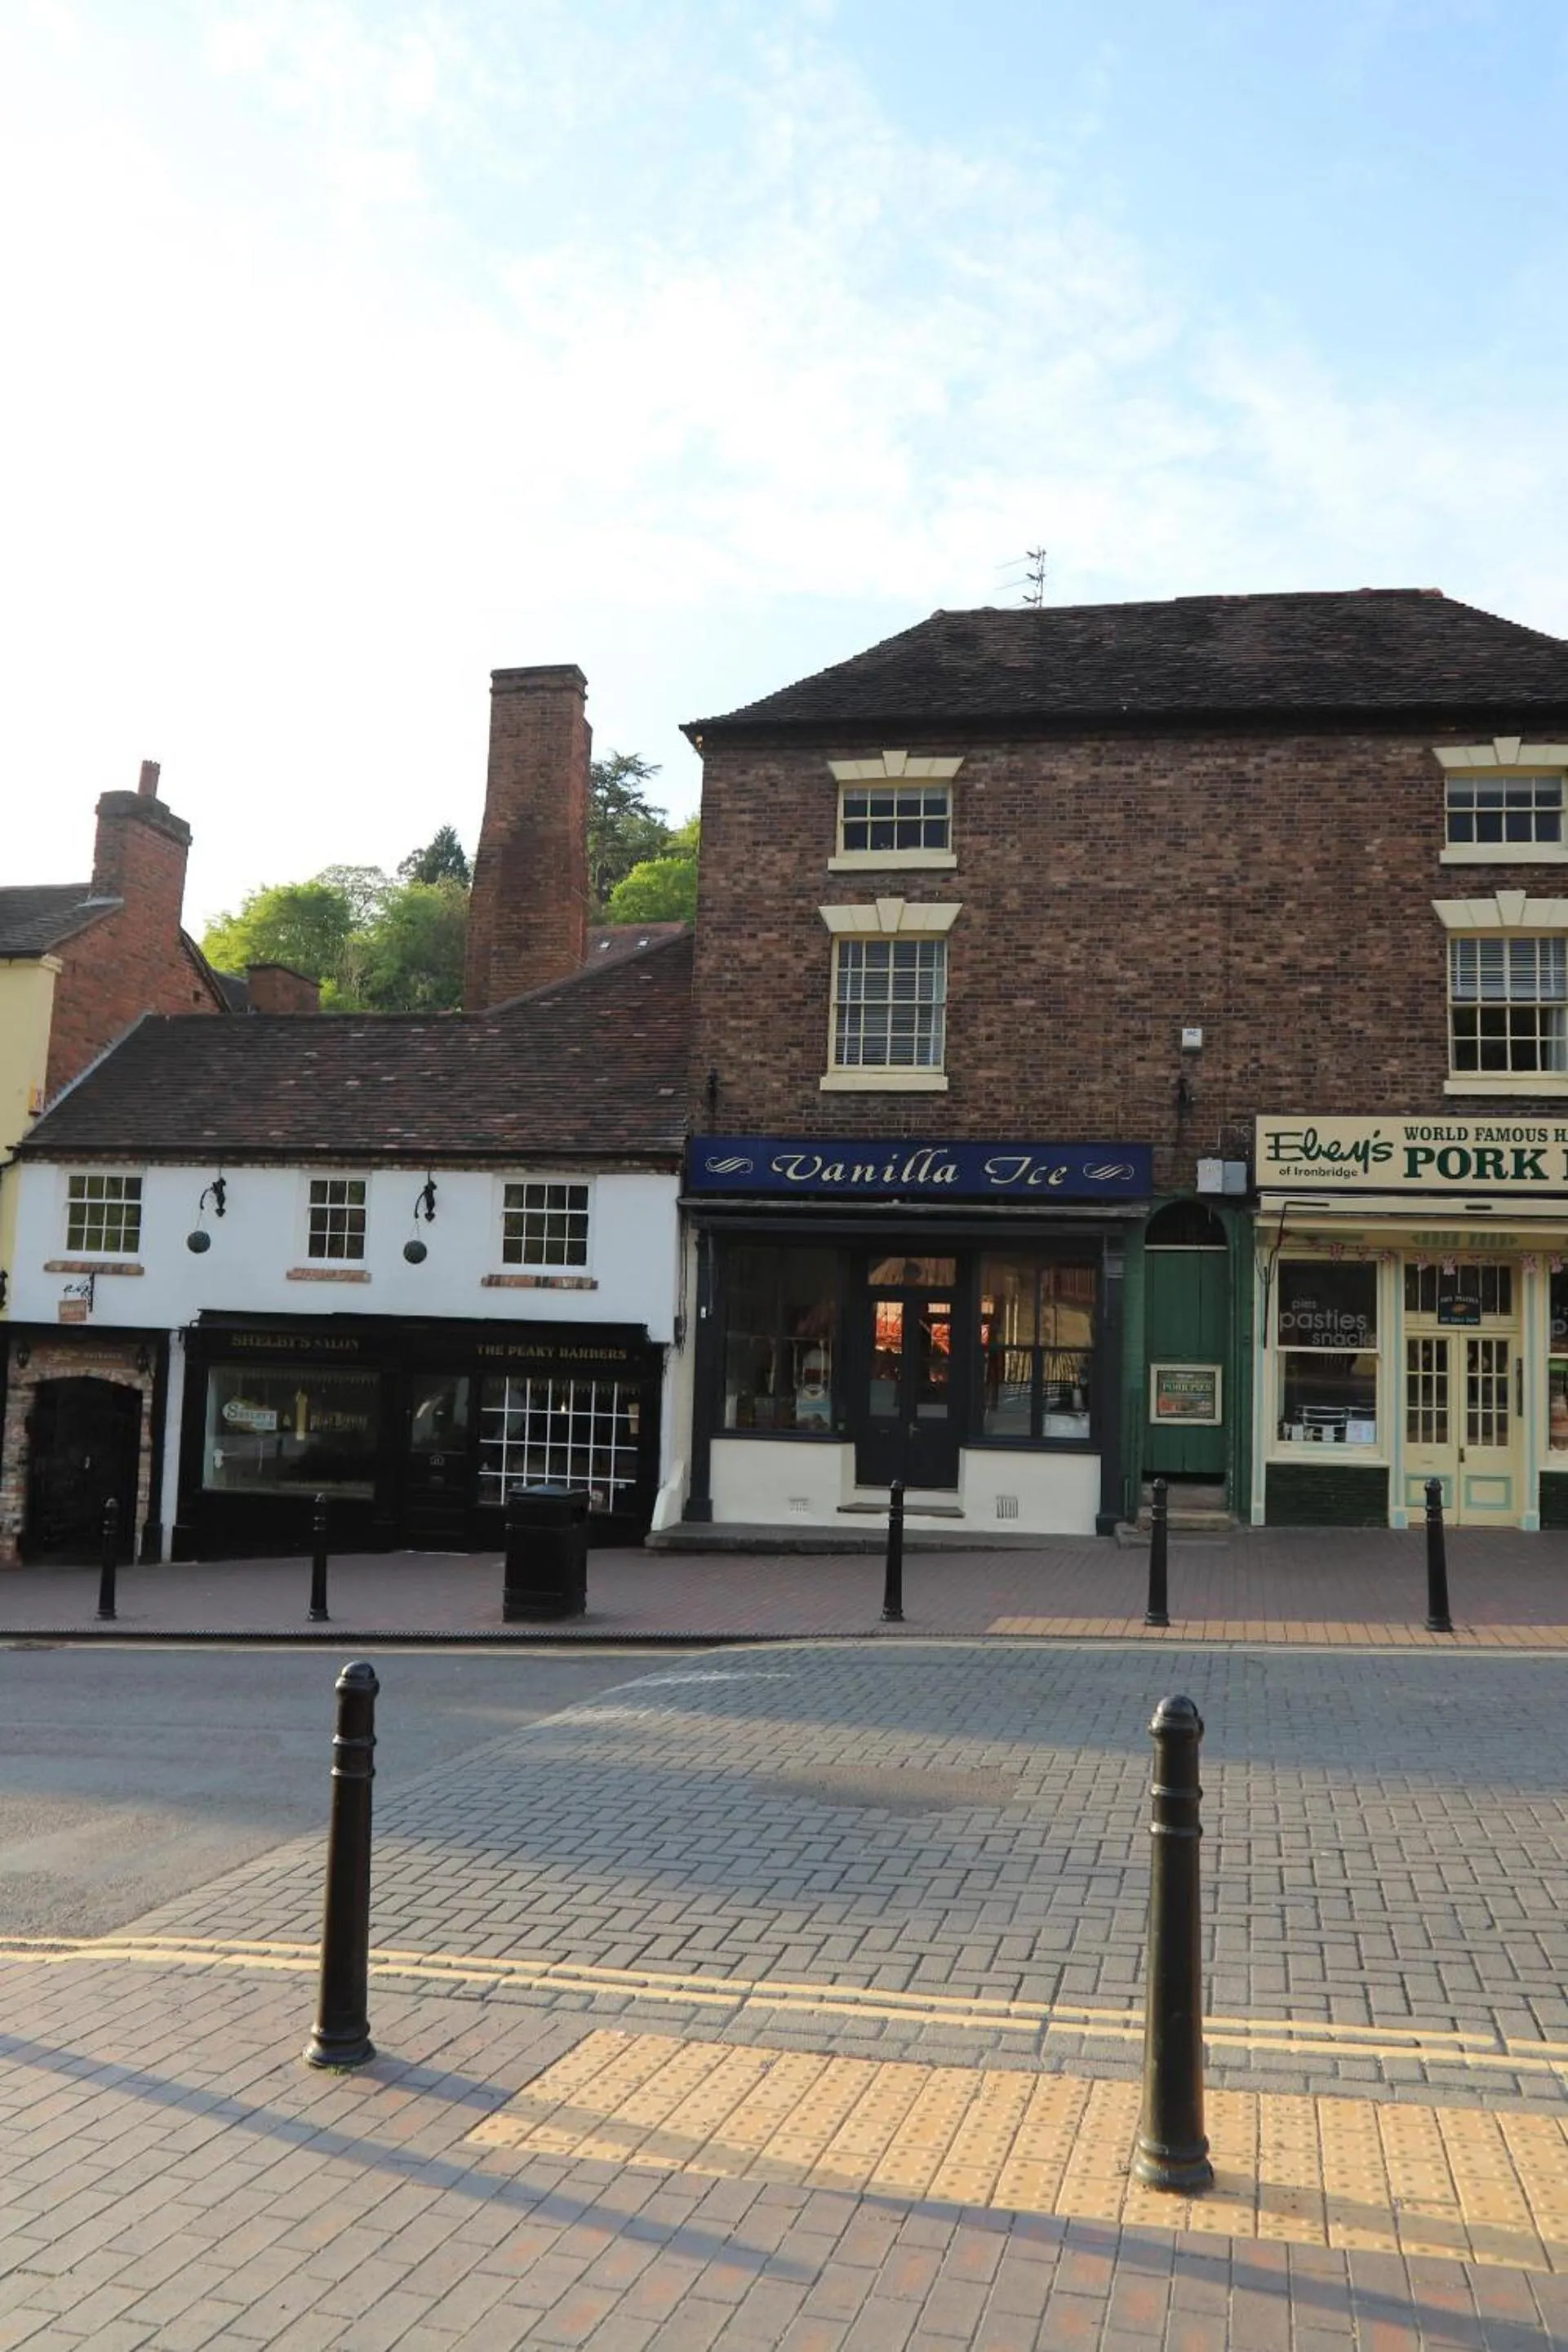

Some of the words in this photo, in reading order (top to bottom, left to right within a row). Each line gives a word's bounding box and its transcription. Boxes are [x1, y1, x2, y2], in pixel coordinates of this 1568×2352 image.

[1404, 1127, 1468, 1141] WORLD
[1474, 1127, 1548, 1142] FAMOUS
[1264, 1127, 1393, 1174] Eley's
[771, 1148, 960, 1184] Vanilla
[984, 1155, 1068, 1185] Ice
[1279, 1166, 1292, 1176] of
[1294, 1166, 1359, 1179] Ironbridge
[1402, 1146, 1549, 1180] PORK
[1279, 1309, 1368, 1332] pasties
[477, 1343, 504, 1356] THE
[508, 1345, 554, 1358] PEAKY
